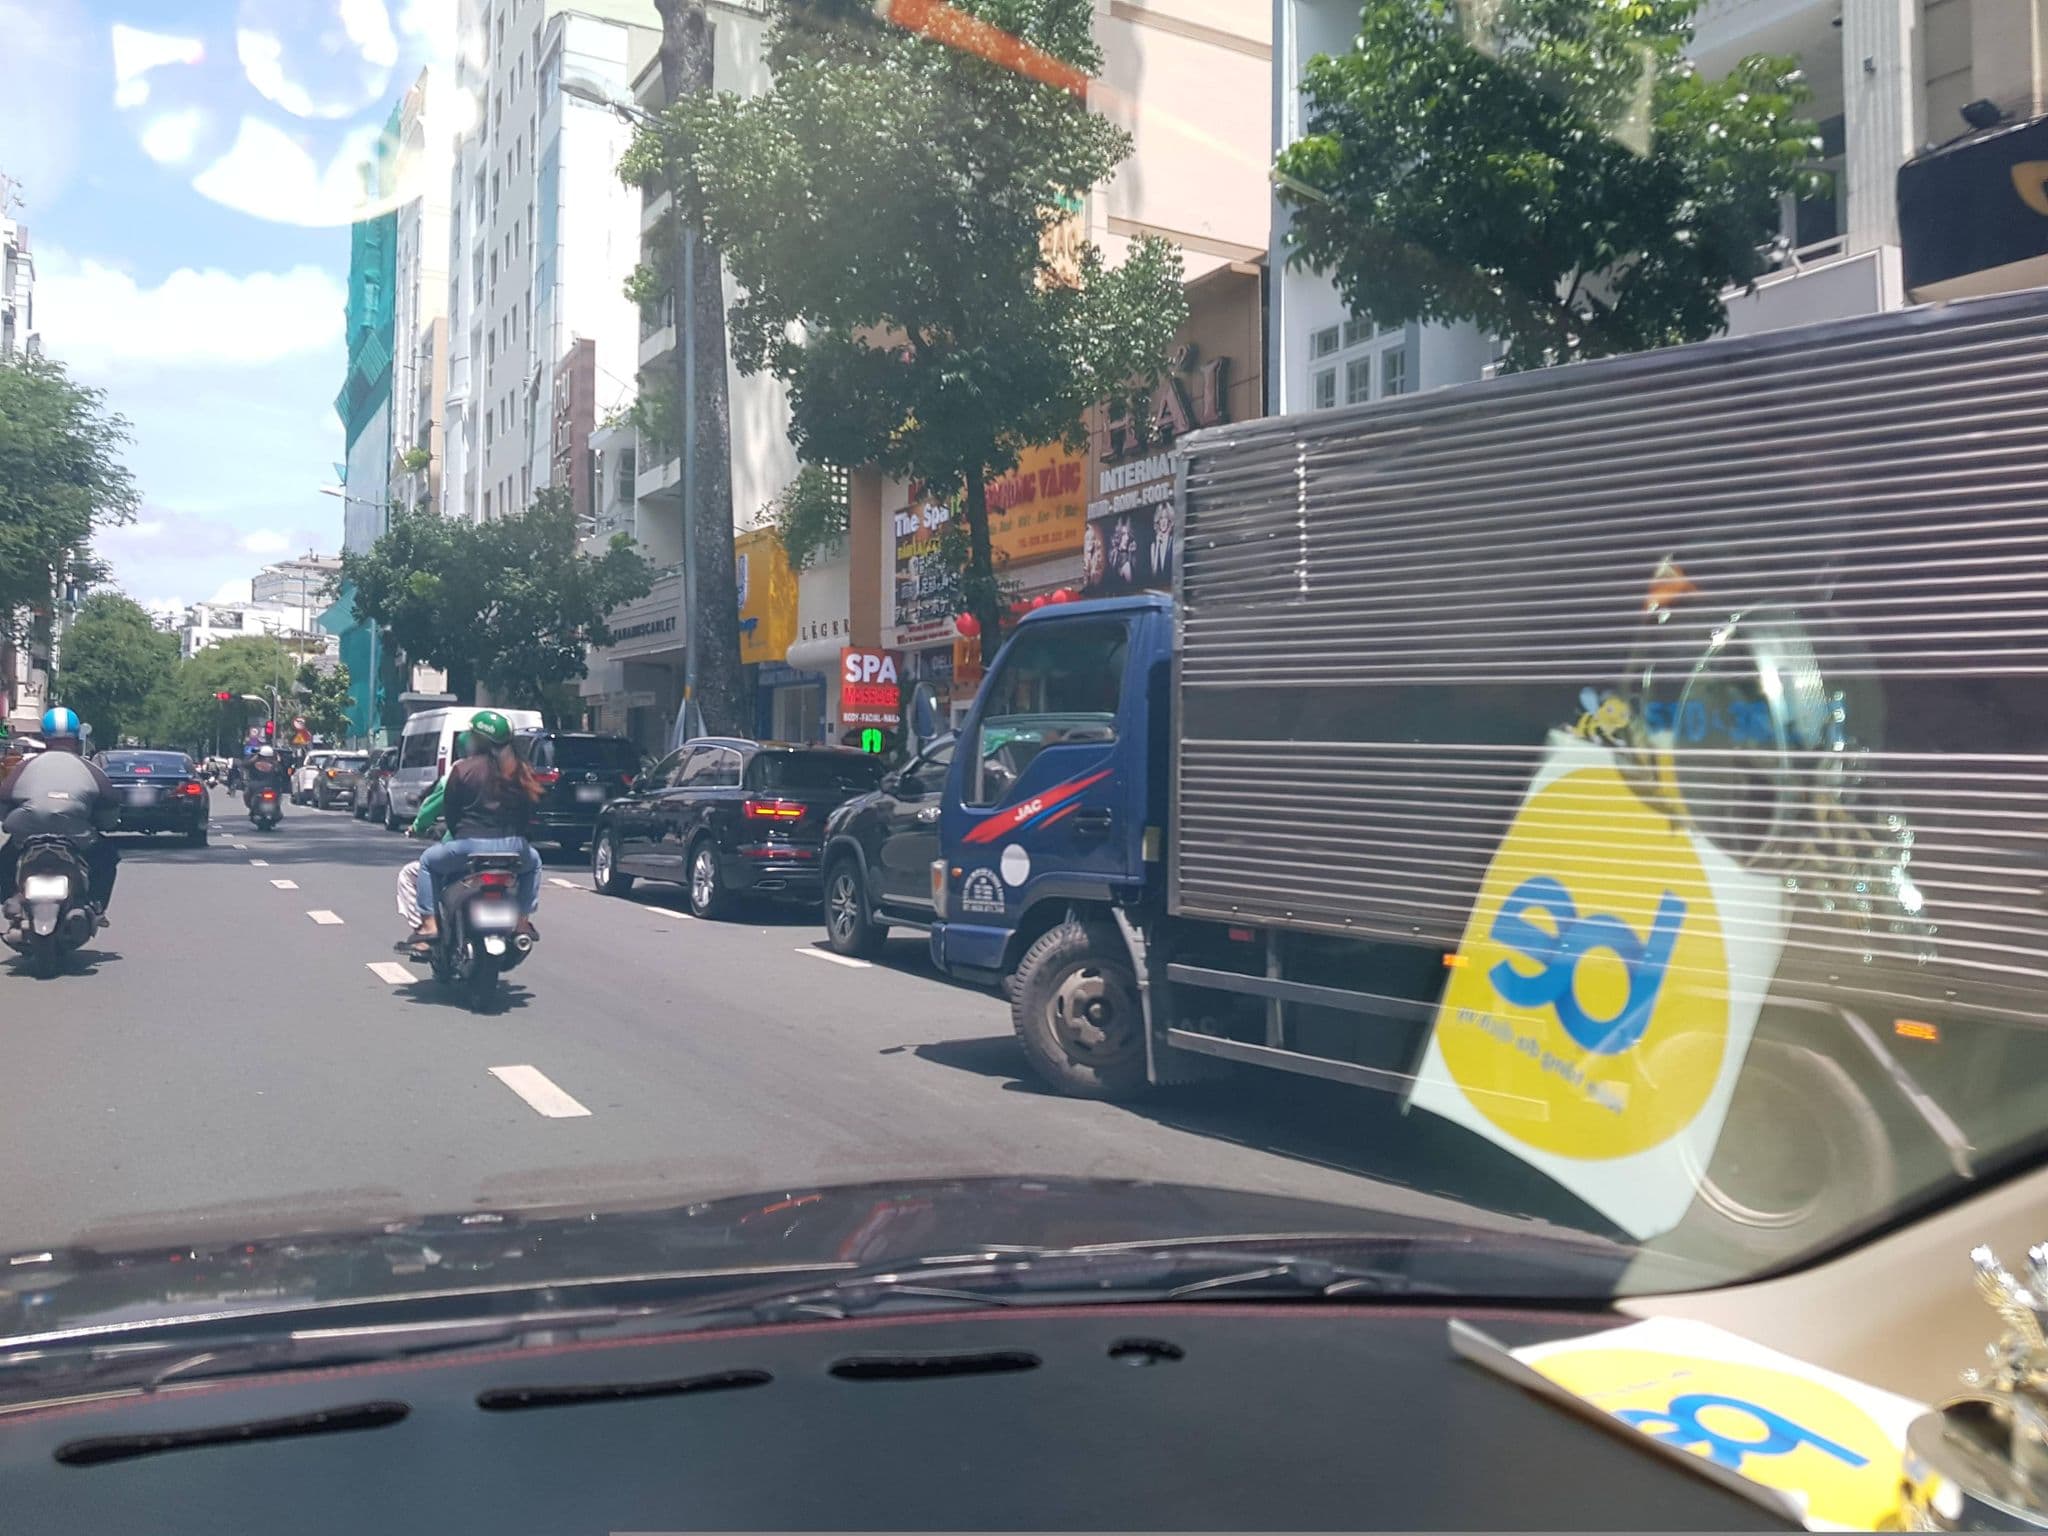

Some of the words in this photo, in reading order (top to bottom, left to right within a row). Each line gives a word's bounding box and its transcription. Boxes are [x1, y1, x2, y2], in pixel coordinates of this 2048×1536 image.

[895, 512, 920, 537] The
[923, 503, 949, 530] Spa
[845, 653, 898, 683] SPA
[1014, 799, 1042, 822] JAC
